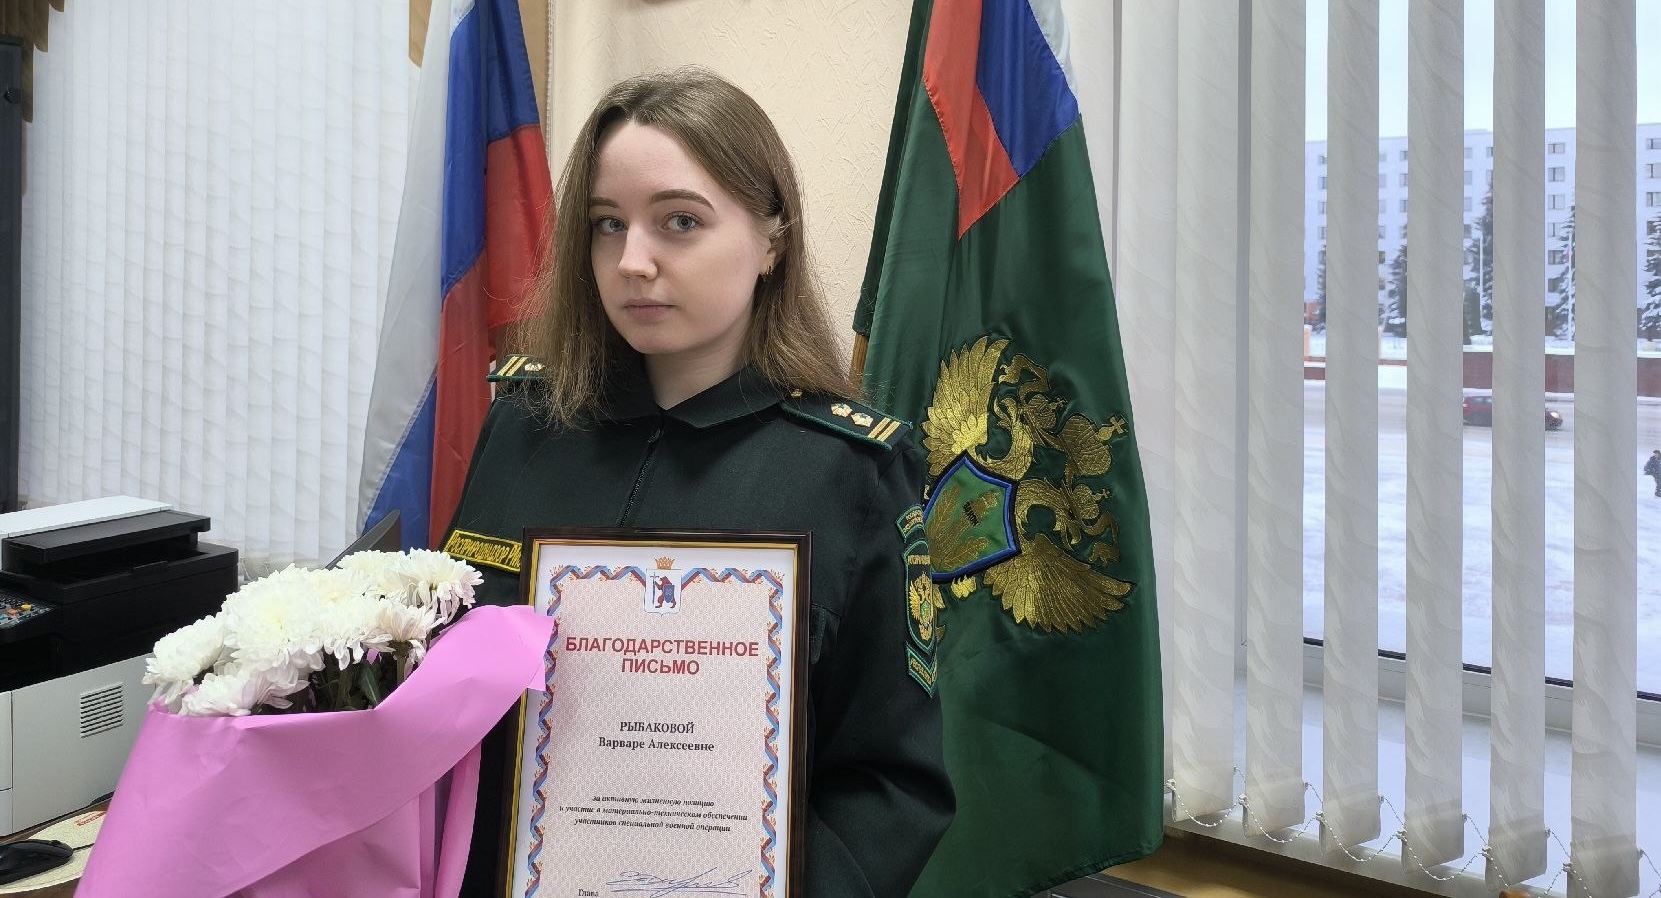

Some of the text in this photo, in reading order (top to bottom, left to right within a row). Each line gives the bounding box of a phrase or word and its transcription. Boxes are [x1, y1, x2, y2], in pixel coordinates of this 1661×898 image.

[565, 637, 759, 656] БЛАГОДАРСТВЕННОЕ
[621, 658, 700, 675] ПИСЬМО
[619, 721, 695, 734] РЫБАКОВОЙ
[598, 736, 715, 751] Варваре Алексеевне
[602, 796, 638, 805] активную
[703, 812, 748, 821] обеспечении
[574, 818, 617, 826] участников
[665, 822, 695, 830] военной
[696, 824, 731, 833] операции
[578, 888, 599, 897] Глава
